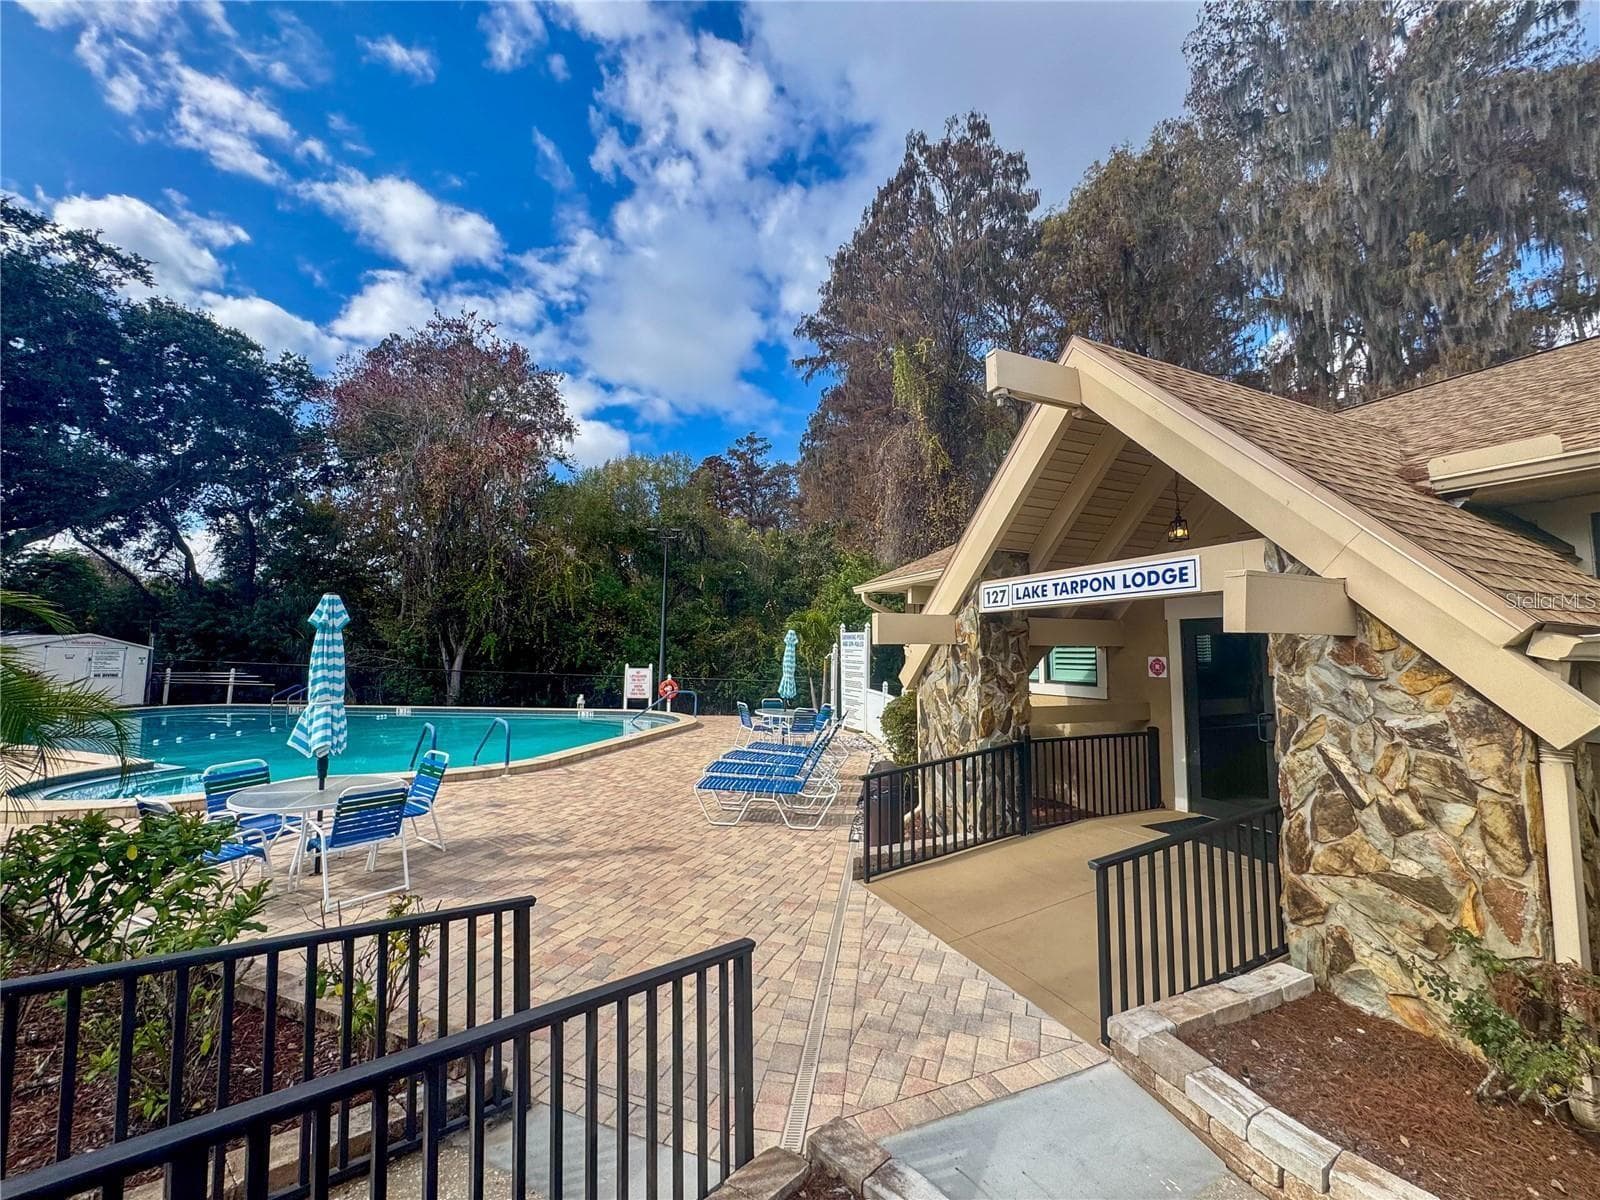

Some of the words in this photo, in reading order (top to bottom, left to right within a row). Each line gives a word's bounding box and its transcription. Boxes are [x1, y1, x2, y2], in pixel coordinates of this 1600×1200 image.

[986, 589, 1007, 605] 127
[1015, 584, 1048, 601] LAKE
[1052, 575, 1116, 597] TARPON
[1122, 566, 1189, 589] LODGE
